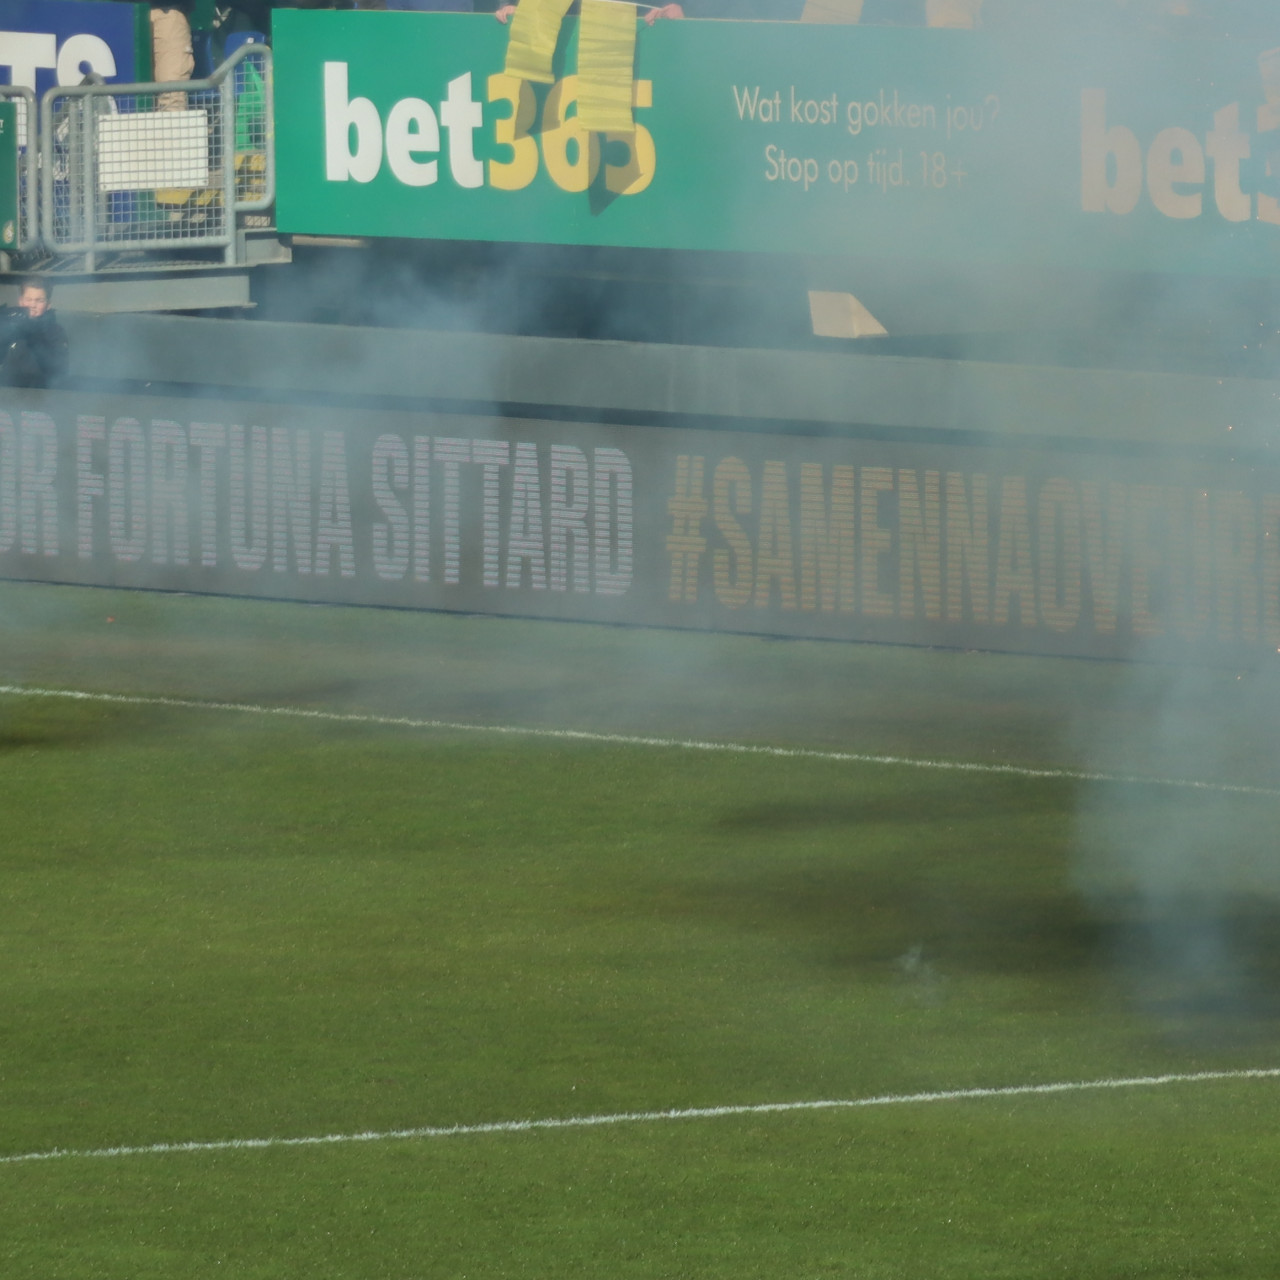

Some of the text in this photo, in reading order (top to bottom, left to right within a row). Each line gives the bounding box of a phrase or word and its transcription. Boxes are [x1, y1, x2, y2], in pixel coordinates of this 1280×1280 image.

[323, 61, 657, 196] bet365
[732, 85, 1000, 140] Wat kost gokken jou?
[765, 144, 819, 192] Stop
[828, 159, 859, 193] op
[919, 151, 969, 189] 18+
[78, 414, 634, 598] FORTUNA SITTARD
